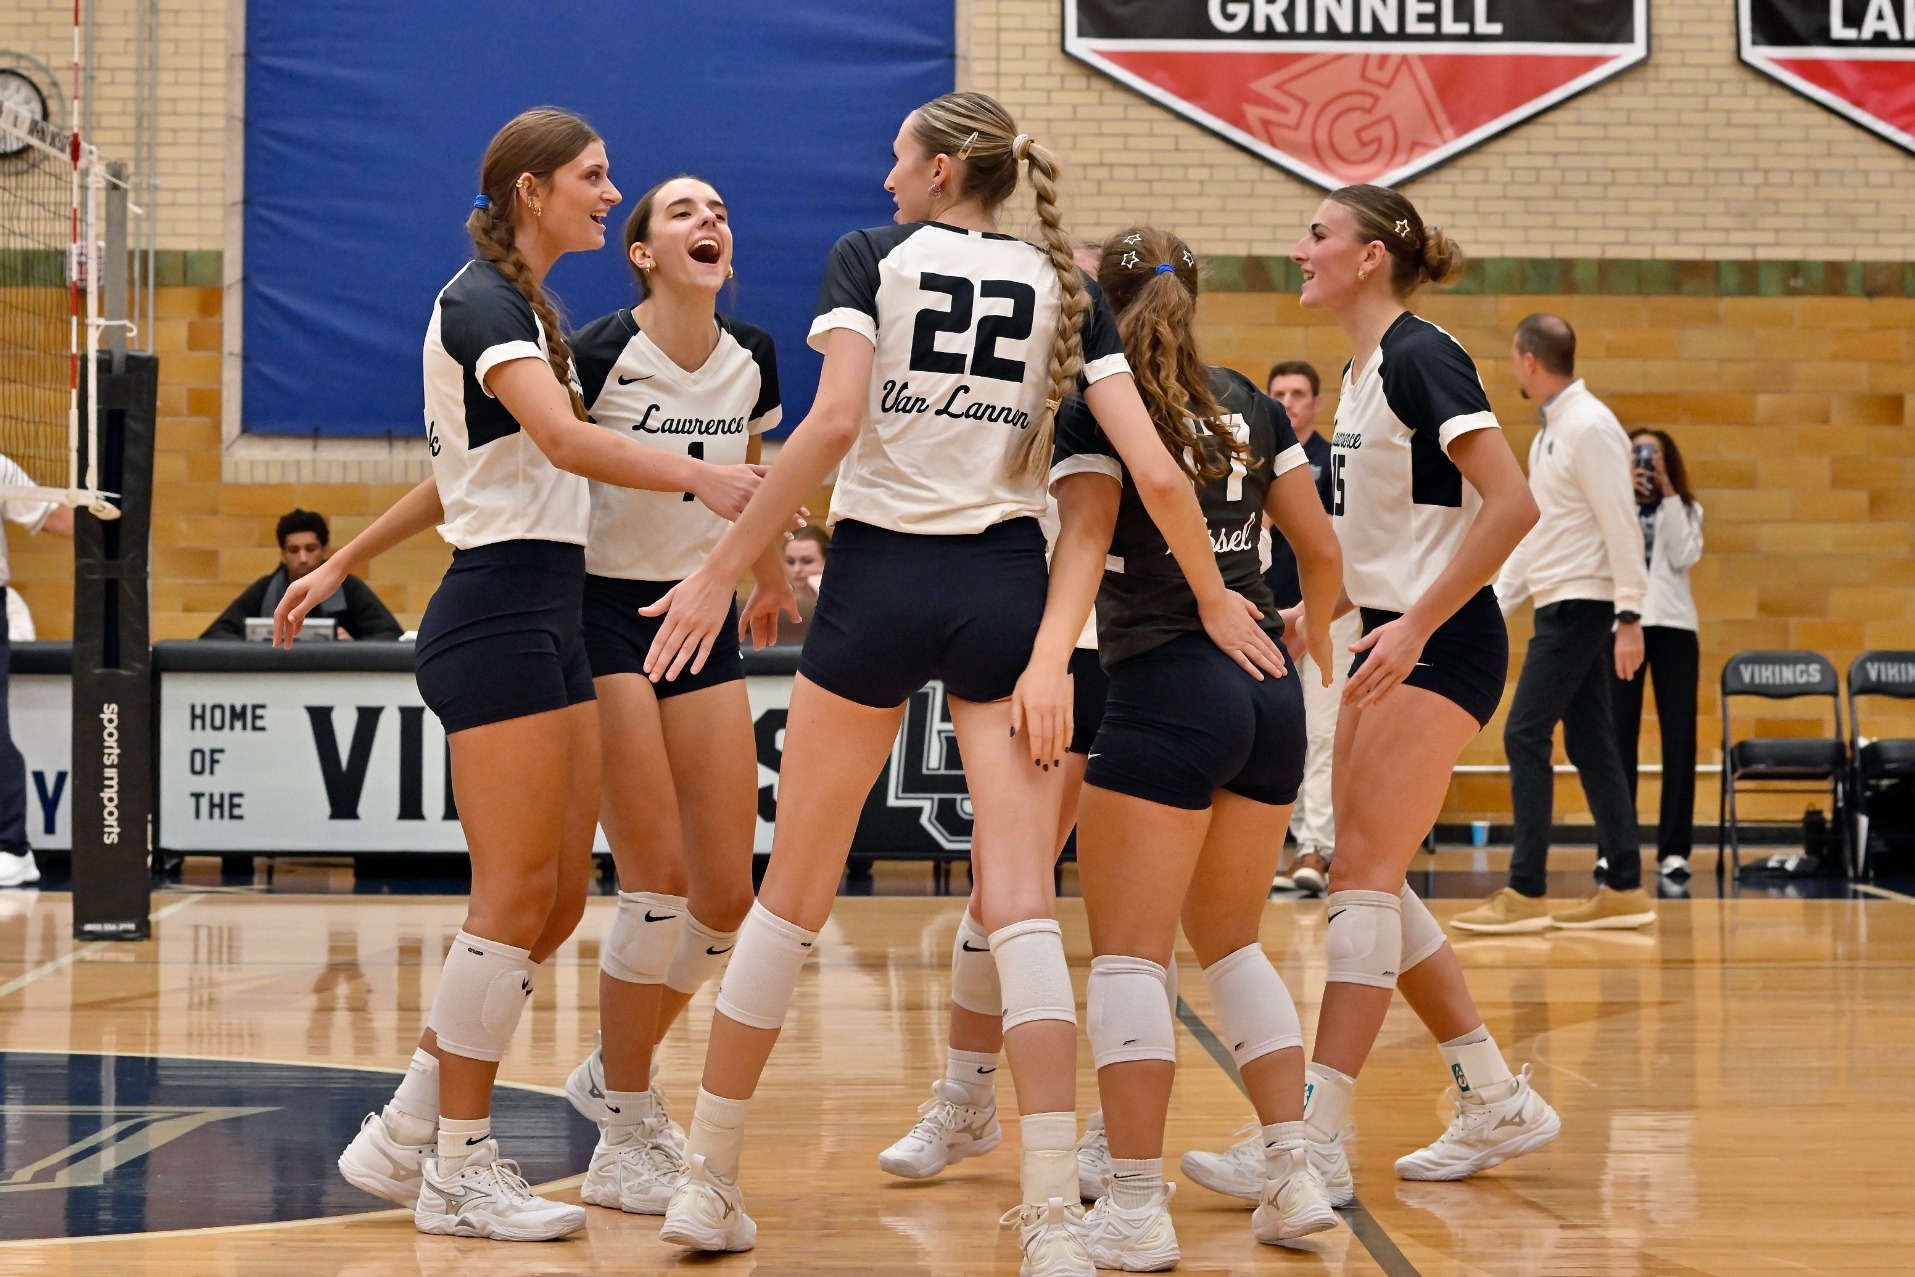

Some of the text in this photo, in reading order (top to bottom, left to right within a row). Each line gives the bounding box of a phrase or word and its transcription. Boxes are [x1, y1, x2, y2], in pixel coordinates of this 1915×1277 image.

[1207, 0, 1504, 34] GRINNELL
[909, 271, 1036, 384] 22
[881, 379, 1030, 430] Van Lannen
[1739, 662, 1822, 685] VIKINGS
[190, 704, 267, 732] HOME
[100, 703, 121, 845] sports imports
[190, 748, 226, 776] OF
[189, 792, 245, 820] THE
